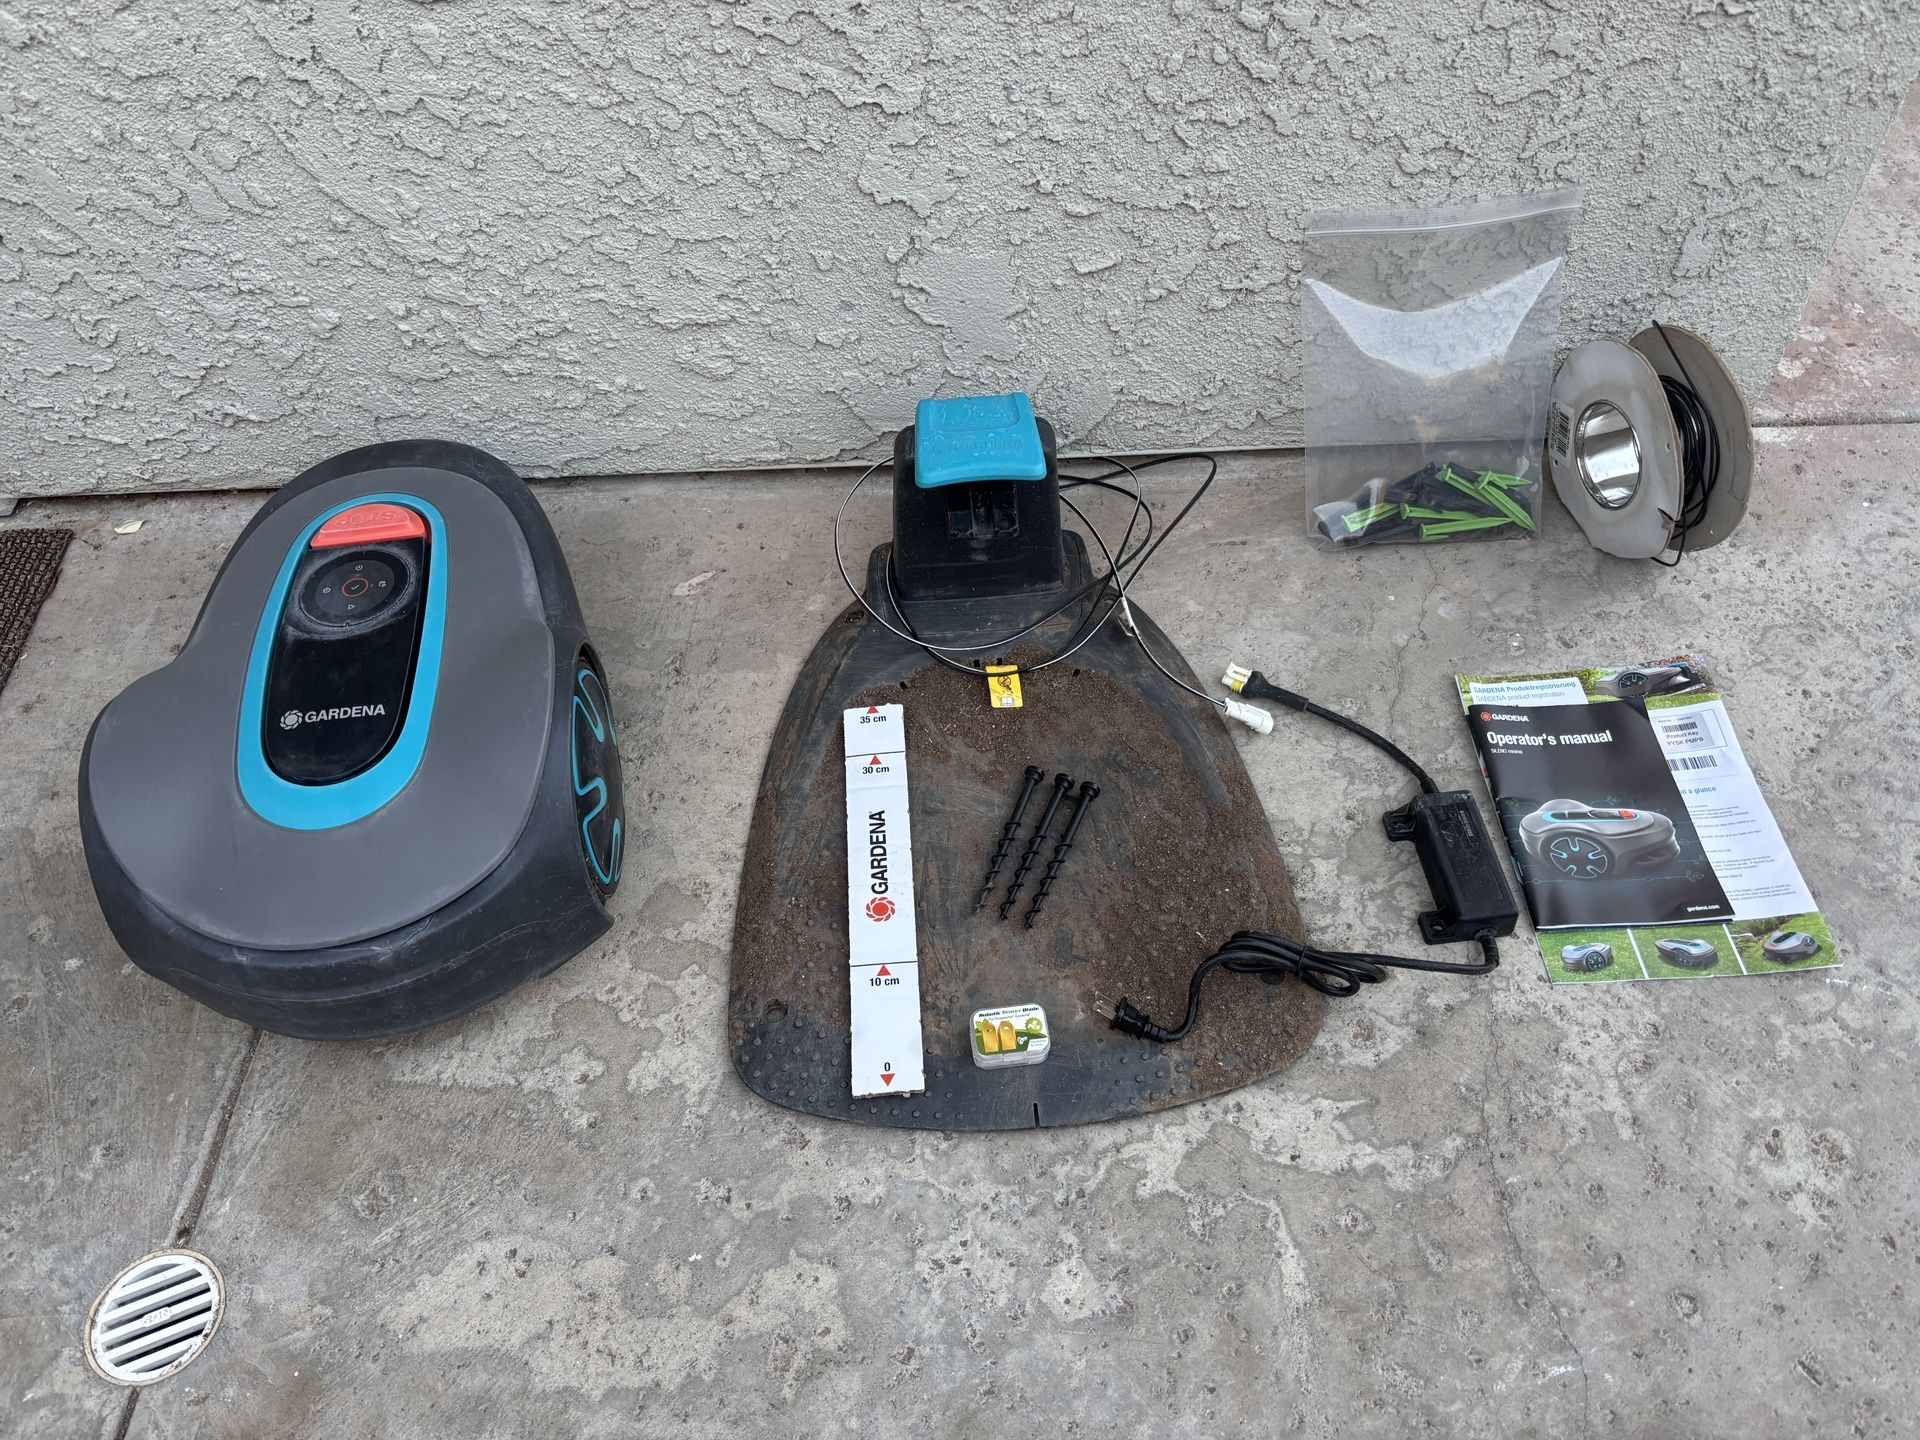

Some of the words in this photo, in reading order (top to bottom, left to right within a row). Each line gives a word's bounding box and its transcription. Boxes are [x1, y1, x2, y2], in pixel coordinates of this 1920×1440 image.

[304, 704, 386, 723] GARDENA
[1492, 713, 1529, 722] GARDENA
[860, 716, 871, 724] 35
[873, 715, 887, 723] cm
[1487, 731, 1556, 747] Operator's
[1560, 730, 1613, 745] manual
[862, 766, 873, 774] 30
[876, 765, 890, 773] cm
[869, 810, 889, 895] GARDENA
[1687, 904, 1720, 912] gardena.com
[870, 977, 882, 987] 10
[884, 977, 900, 986] cm
[884, 1062, 891, 1071] 0
